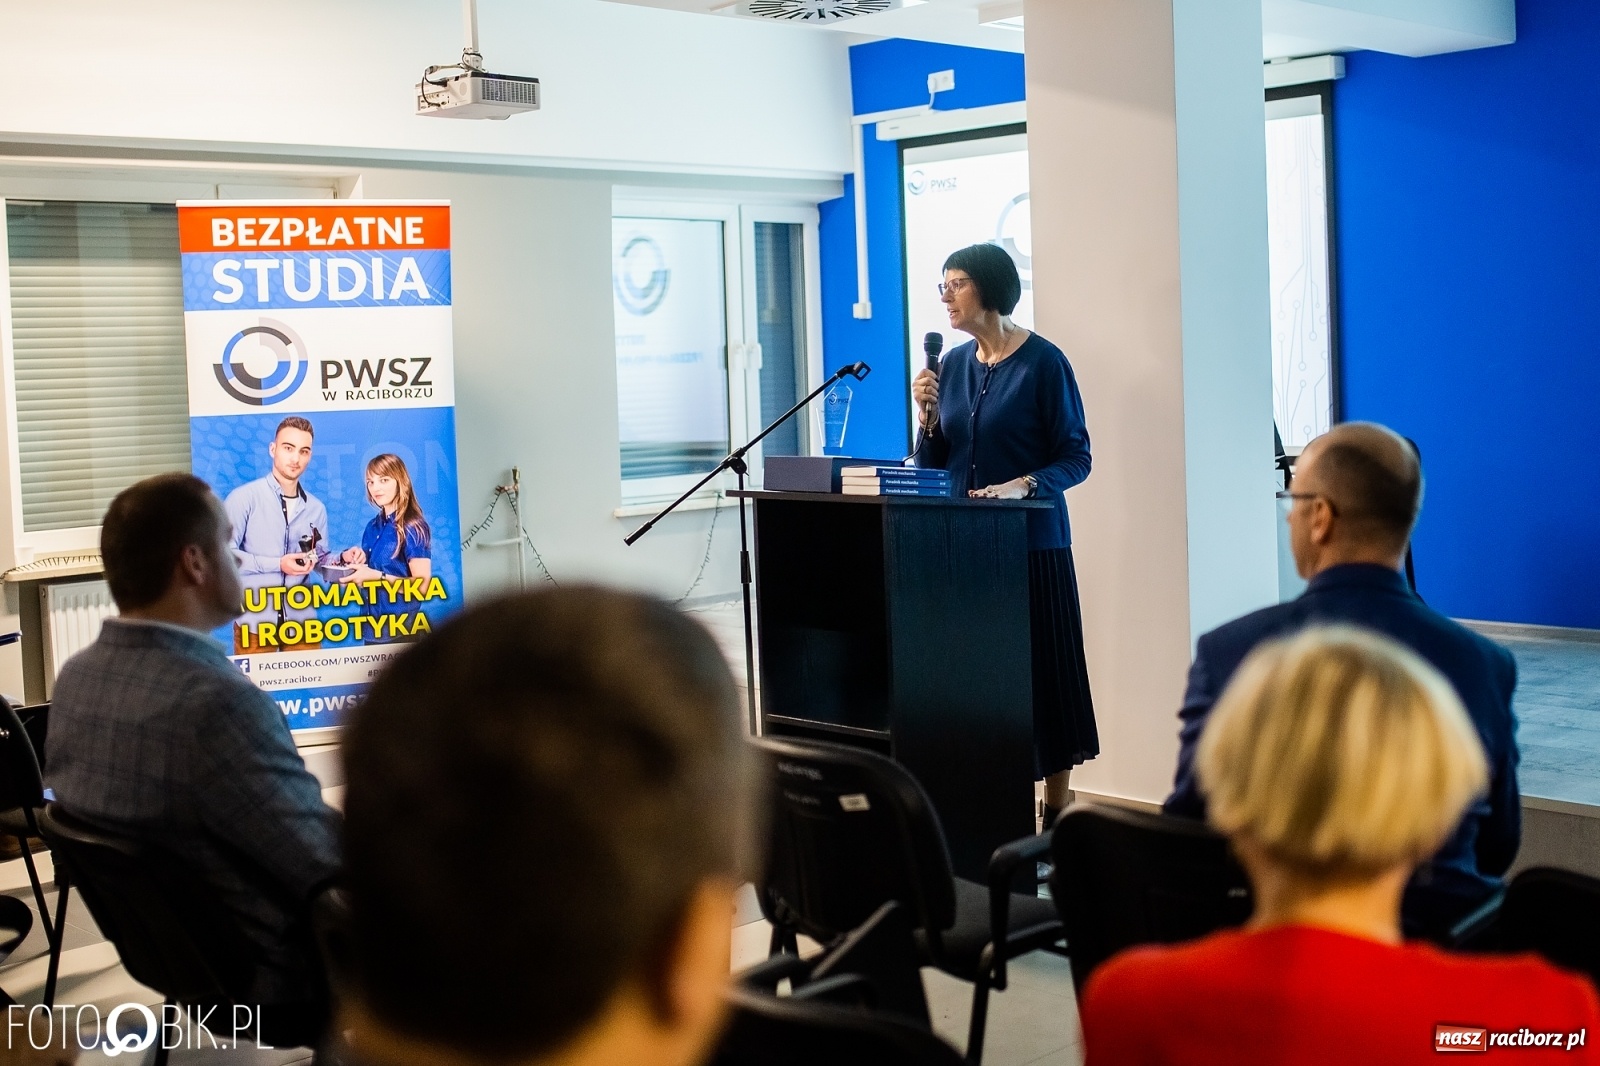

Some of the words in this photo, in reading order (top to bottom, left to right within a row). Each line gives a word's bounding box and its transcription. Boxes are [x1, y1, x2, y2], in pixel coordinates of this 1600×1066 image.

[930, 177, 957, 189] PWSZ
[211, 216, 425, 247] BEZPŁATNE
[212, 257, 431, 304] STUDIA
[320, 357, 432, 389] PWSZ
[322, 390, 337, 401] W
[345, 388, 433, 400] RACIBORZU
[241, 577, 447, 613] UTOMATYKA
[241, 624, 250, 648] I
[258, 612, 432, 647] ROBOTYKA
[258, 657, 342, 671] FACEBOOK.COM/
[259, 674, 322, 687] pwsz.raciborz
